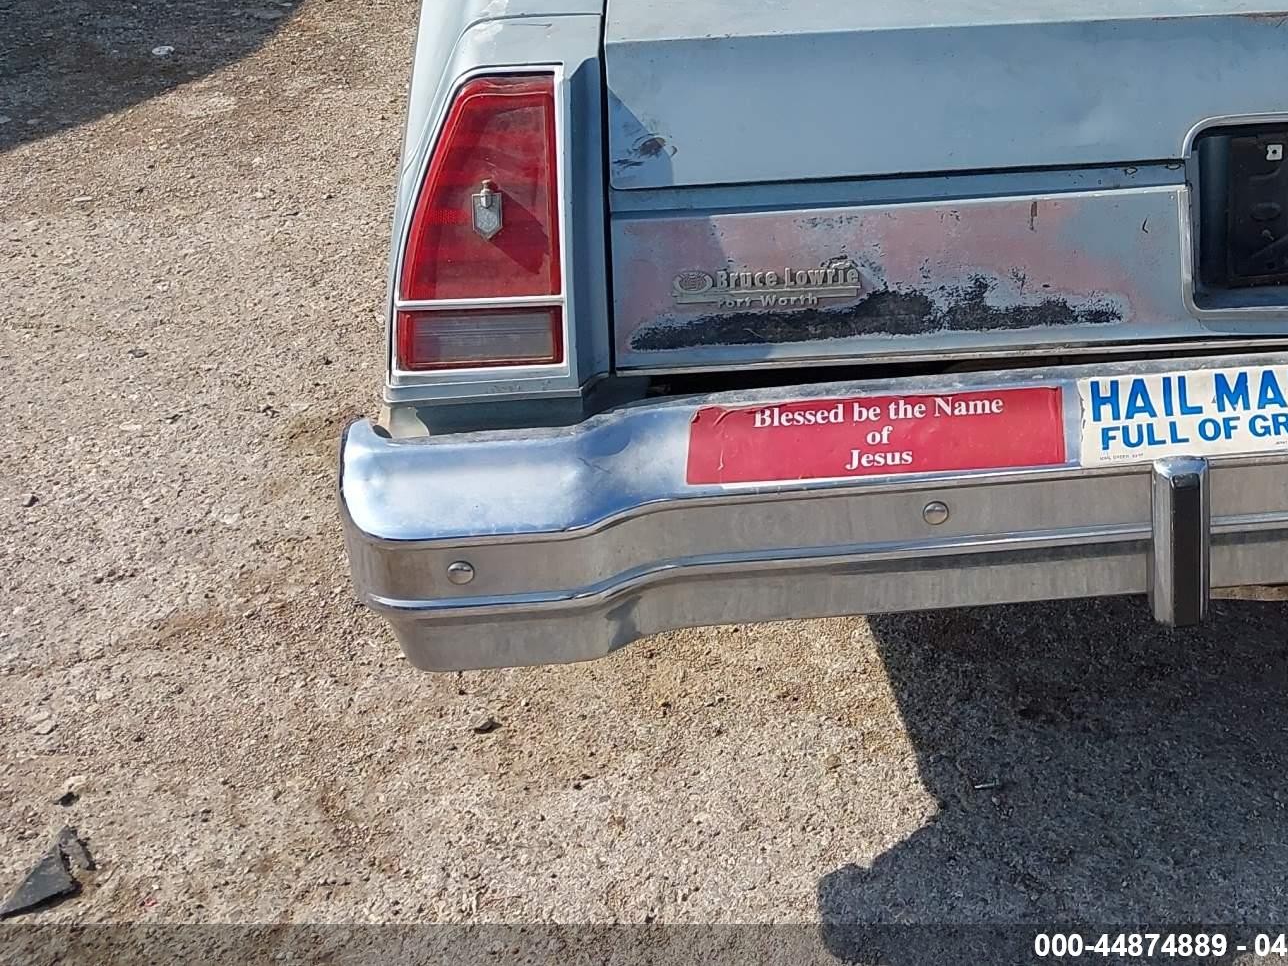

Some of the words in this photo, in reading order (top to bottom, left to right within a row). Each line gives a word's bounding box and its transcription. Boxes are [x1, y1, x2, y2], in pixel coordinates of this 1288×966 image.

[716, 270, 777, 290] Bruce
[784, 267, 860, 289] Lowrie
[760, 293, 818, 307] Worth
[1090, 375, 1204, 423] HAIL
[753, 403, 845, 429] Blessed
[852, 400, 881, 422] be
[888, 398, 927, 420] the
[933, 396, 1004, 418] Name
[866, 425, 893, 446] of
[1101, 420, 1190, 451] FULL
[1198, 416, 1241, 442] OF
[845, 449, 912, 471] Jesus
